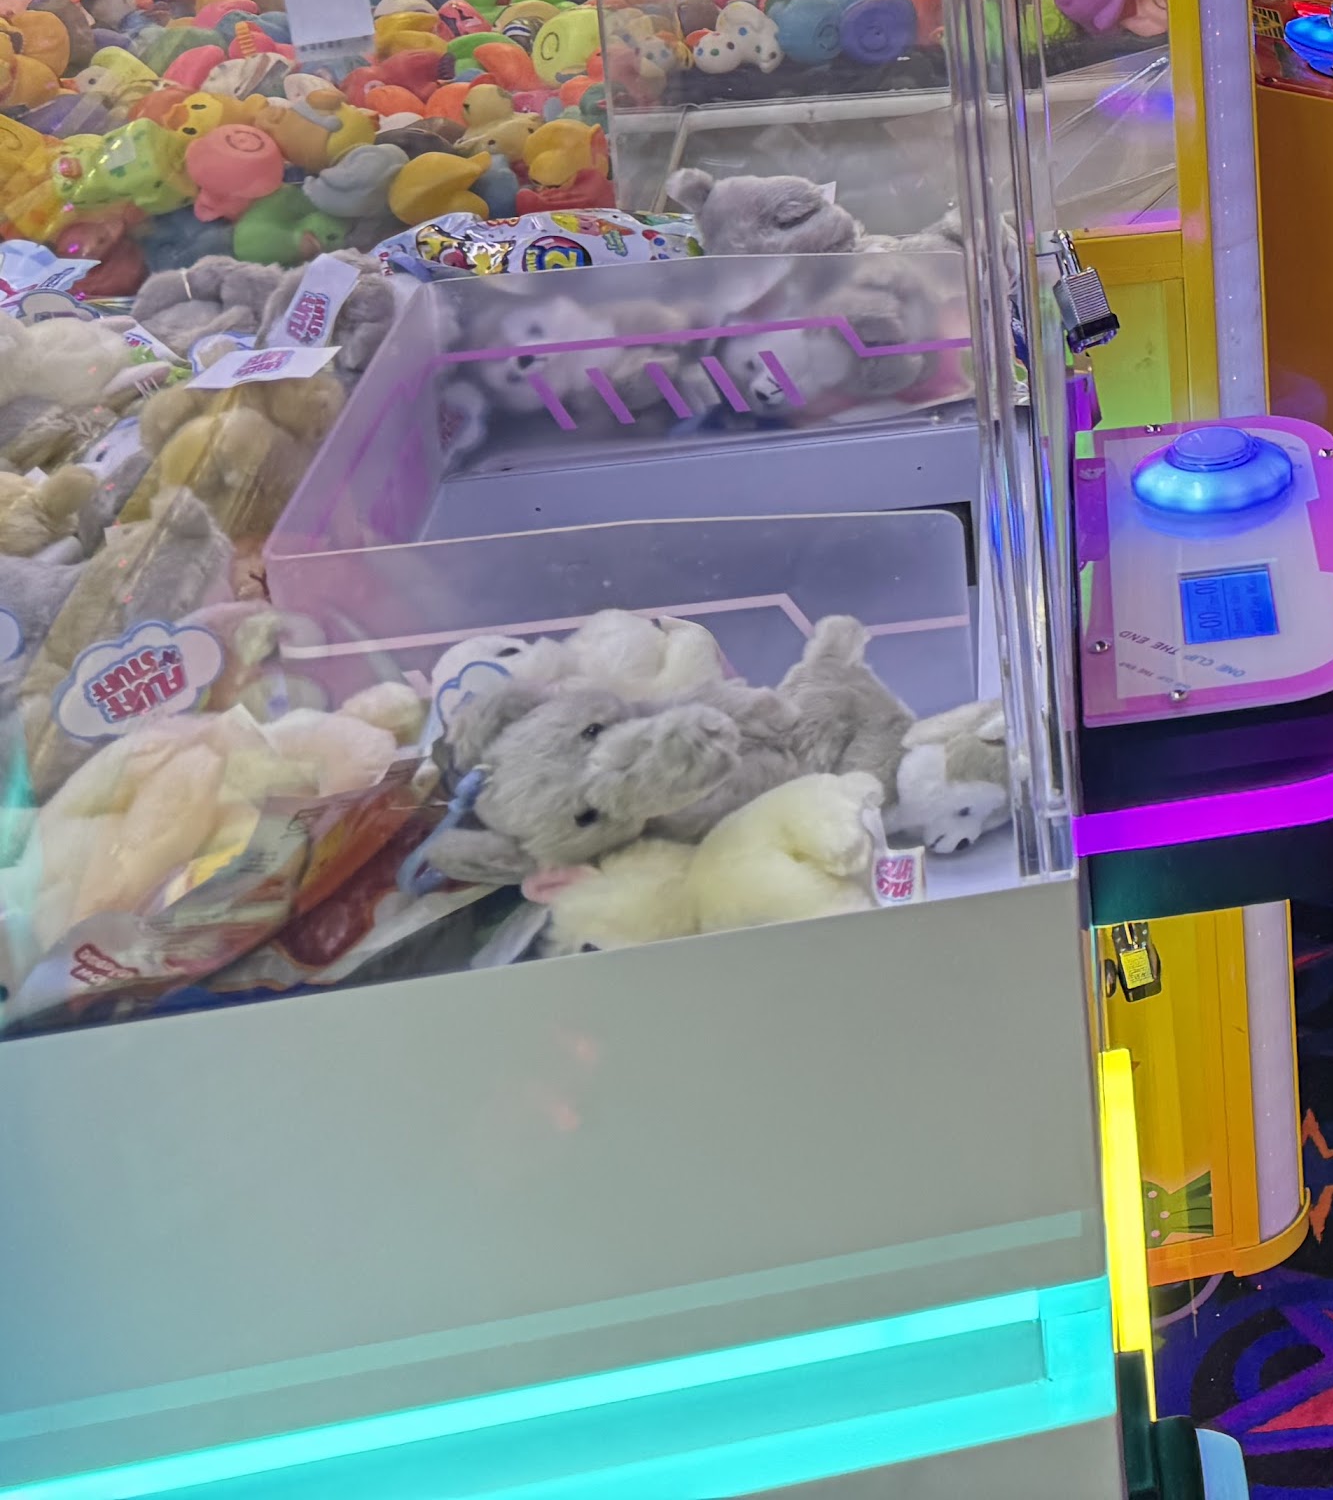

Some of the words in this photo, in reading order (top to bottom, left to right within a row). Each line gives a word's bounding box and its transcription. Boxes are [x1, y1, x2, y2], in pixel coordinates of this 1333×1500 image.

[1117, 629, 1150, 645] END
[1151, 640, 1180, 656] THE
[1182, 653, 1215, 669] CLIP
[1216, 663, 1247, 679] ONE
